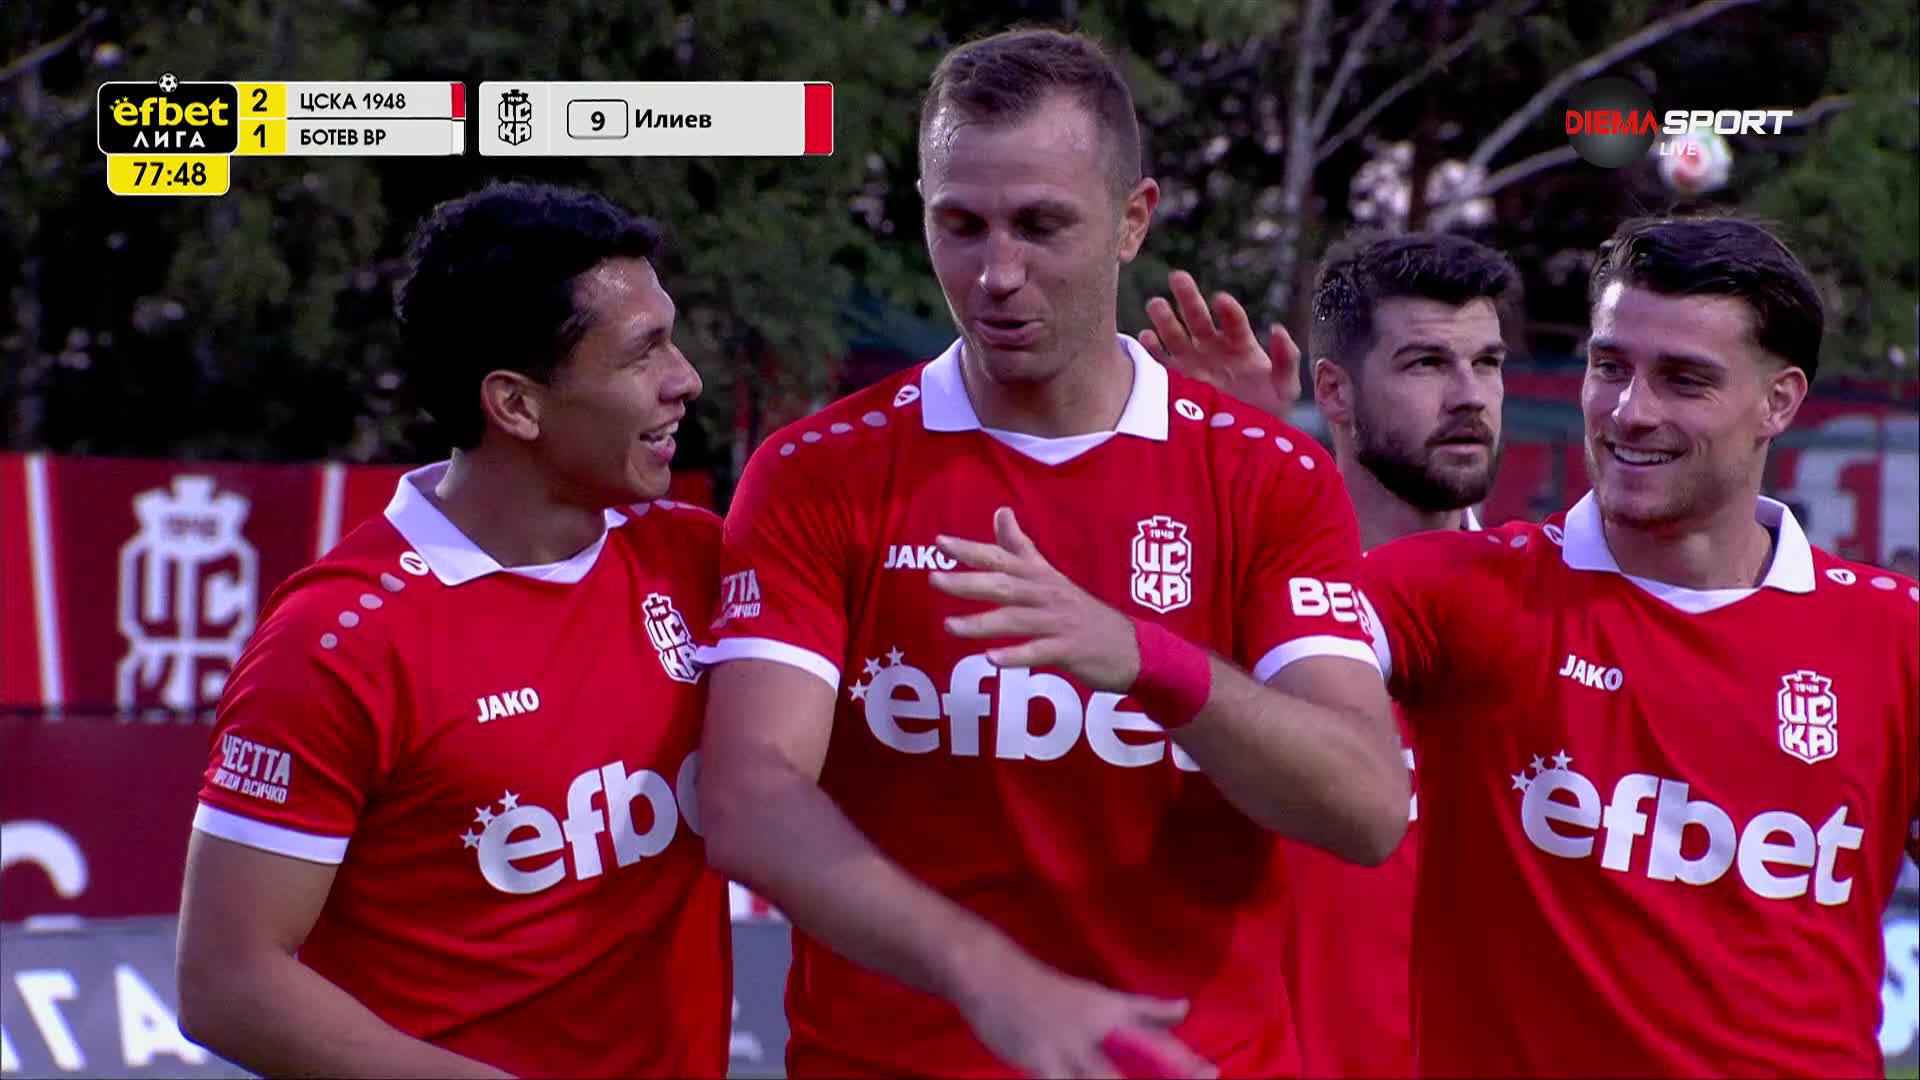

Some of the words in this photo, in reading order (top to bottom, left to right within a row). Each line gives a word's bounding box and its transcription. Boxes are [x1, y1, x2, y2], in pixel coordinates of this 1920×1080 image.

[477, 687, 540, 723] JAKO
[1559, 654, 1623, 691] JAKO
[864, 653, 1201, 772] efbe
[1522, 768, 1864, 906] efbet
